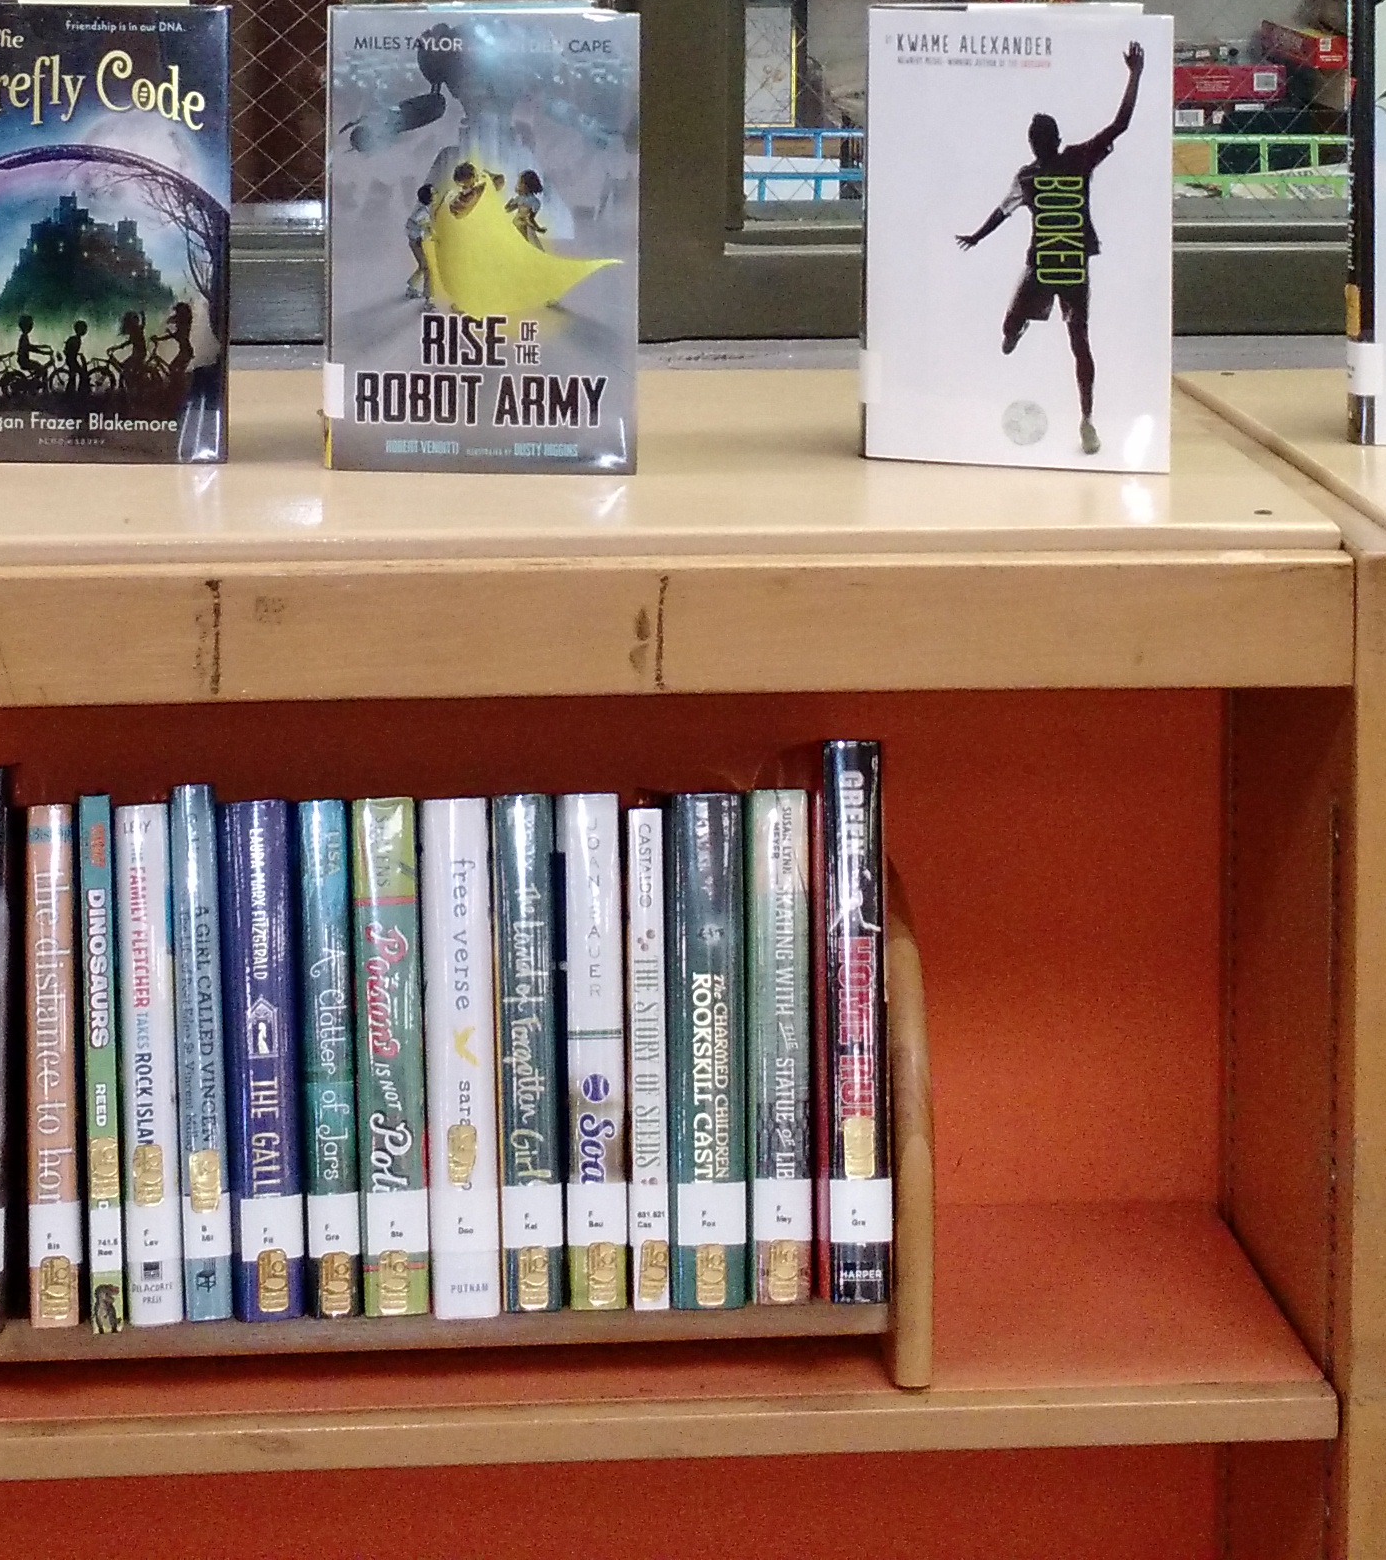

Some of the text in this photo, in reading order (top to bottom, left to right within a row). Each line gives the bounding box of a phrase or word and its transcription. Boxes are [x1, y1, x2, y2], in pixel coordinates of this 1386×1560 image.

[118, 22, 126, 31] is
[129, 22, 137, 31] in
[140, 23, 156, 32] our
[354, 36, 401, 50] MILES
[405, 36, 463, 51] TAYLOR
[569, 39, 612, 54] CAPE
[897, 33, 1052, 56] KWAME ALEXANDER
[96, 49, 205, 131] Code
[1034, 176, 1086, 286] BOOKED
[421, 313, 537, 367] RISE OF
[514, 343, 540, 366] THE
[30, 411, 82, 431] Frazer
[89, 413, 178, 432] Blakemore
[355, 372, 609, 428] ROBOT ARMY
[123, 821, 151, 833] LEY
[839, 770, 866, 856] GREEN
[327, 831, 340, 876] LISA
[638, 823, 652, 908] CASTALDO
[782, 807, 792, 874] SUSAN LYNN
[34, 871, 70, 925] the
[130, 867, 146, 922] FAMILY
[249, 828, 268, 980] LAURA MARX FITZGERALD
[515, 884, 541, 919] The
[452, 858, 475, 1011] free verse
[513, 921, 549, 977] Land
[775, 885, 794, 959] SKATING
[87, 889, 109, 1050] DINOSAURS
[133, 931, 149, 1008] FLETCHER
[365, 920, 409, 1058] Poison
[775, 965, 794, 1016] WITH
[838, 936, 874, 1042] HOME
[34, 935, 70, 1087] distance
[503, 984, 544, 1013] of
[137, 1013, 149, 1049] TAKES
[195, 906, 215, 1150] A GIRL CALLED VINCEN
[319, 990, 346, 1075] Clatter
[692, 972, 712, 1105] ROOKSKILL
[782, 1025, 798, 1050] THE
[135, 1053, 153, 1098] ROCK
[184, 1061, 194, 1109] Vincent
[374, 1063, 390, 1076] IS
[503, 1015, 545, 1124] Forgotten
[634, 955, 661, 1168] THE STORY OF SEEDS
[713, 974, 729, 1178] The CHARMED CHILDREN
[36, 1100, 67, 1134] to
[95, 1084, 107, 1127] REED
[251, 1076, 278, 1119] THE
[322, 1090, 350, 1114] of
[379, 1080, 402, 1111] NOT
[776, 1058, 794, 1123] STATUE
[318, 1125, 348, 1180] Jars
[781, 1129, 795, 1147] OF
[450, 1283, 489, 1293] PUTNAM
[840, 1269, 882, 1279] HARPER
